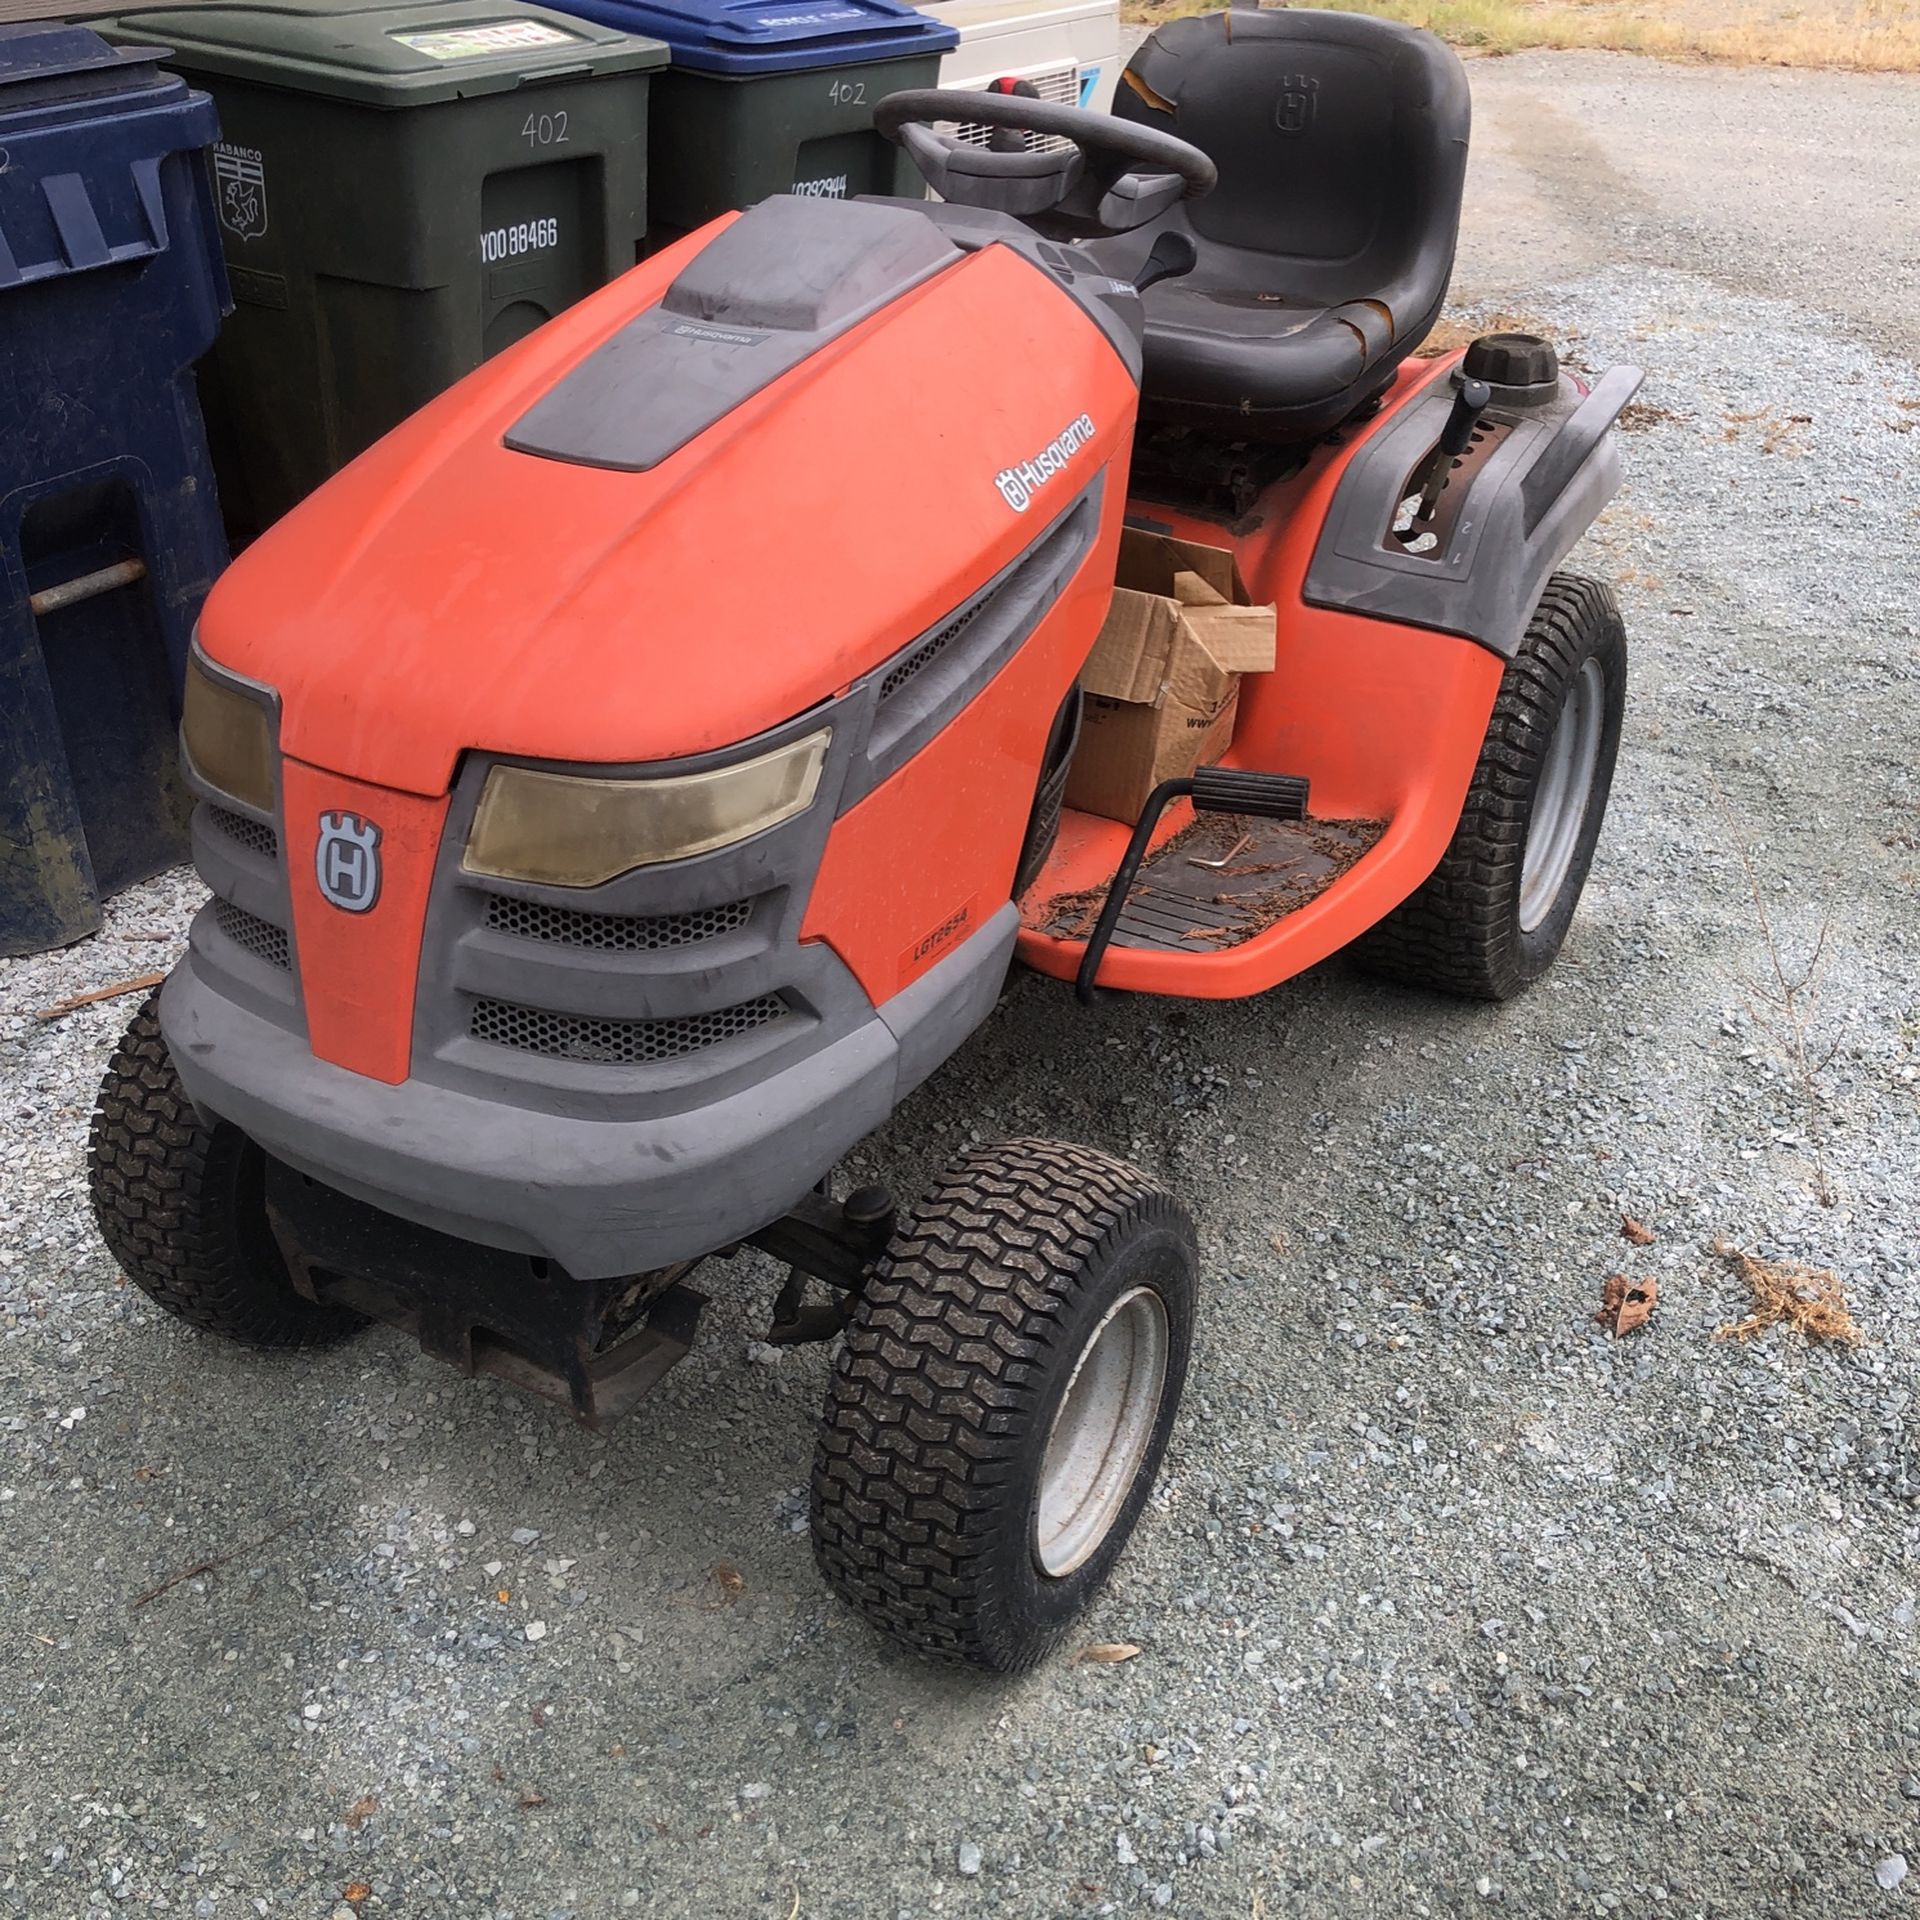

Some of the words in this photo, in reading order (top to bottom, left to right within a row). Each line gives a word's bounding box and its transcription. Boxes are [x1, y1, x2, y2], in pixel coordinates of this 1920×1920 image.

[828, 80, 867, 106] 402
[521, 111, 570, 148] 402
[480, 217, 558, 264] Y0088466
[1013, 412, 1096, 495] Husqvarna
